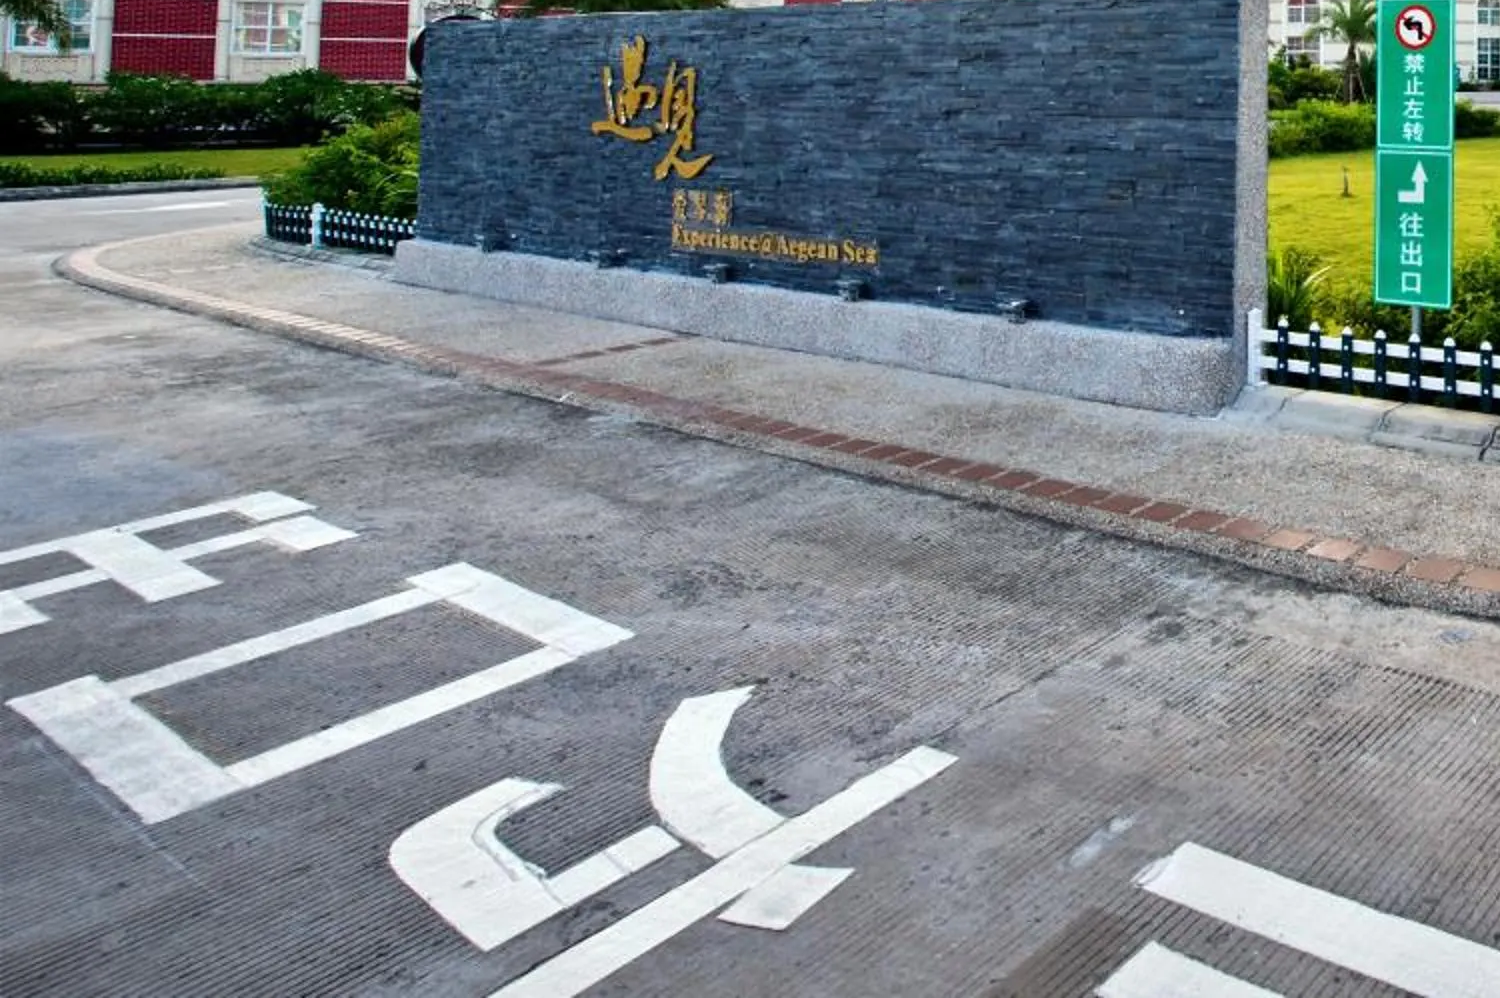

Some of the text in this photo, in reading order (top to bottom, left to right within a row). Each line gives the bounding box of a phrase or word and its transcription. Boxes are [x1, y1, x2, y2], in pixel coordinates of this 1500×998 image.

[1403, 54, 1425, 142] 禁止左转
[843, 239, 878, 265] Sea
[1399, 212, 1425, 293] 往出口
